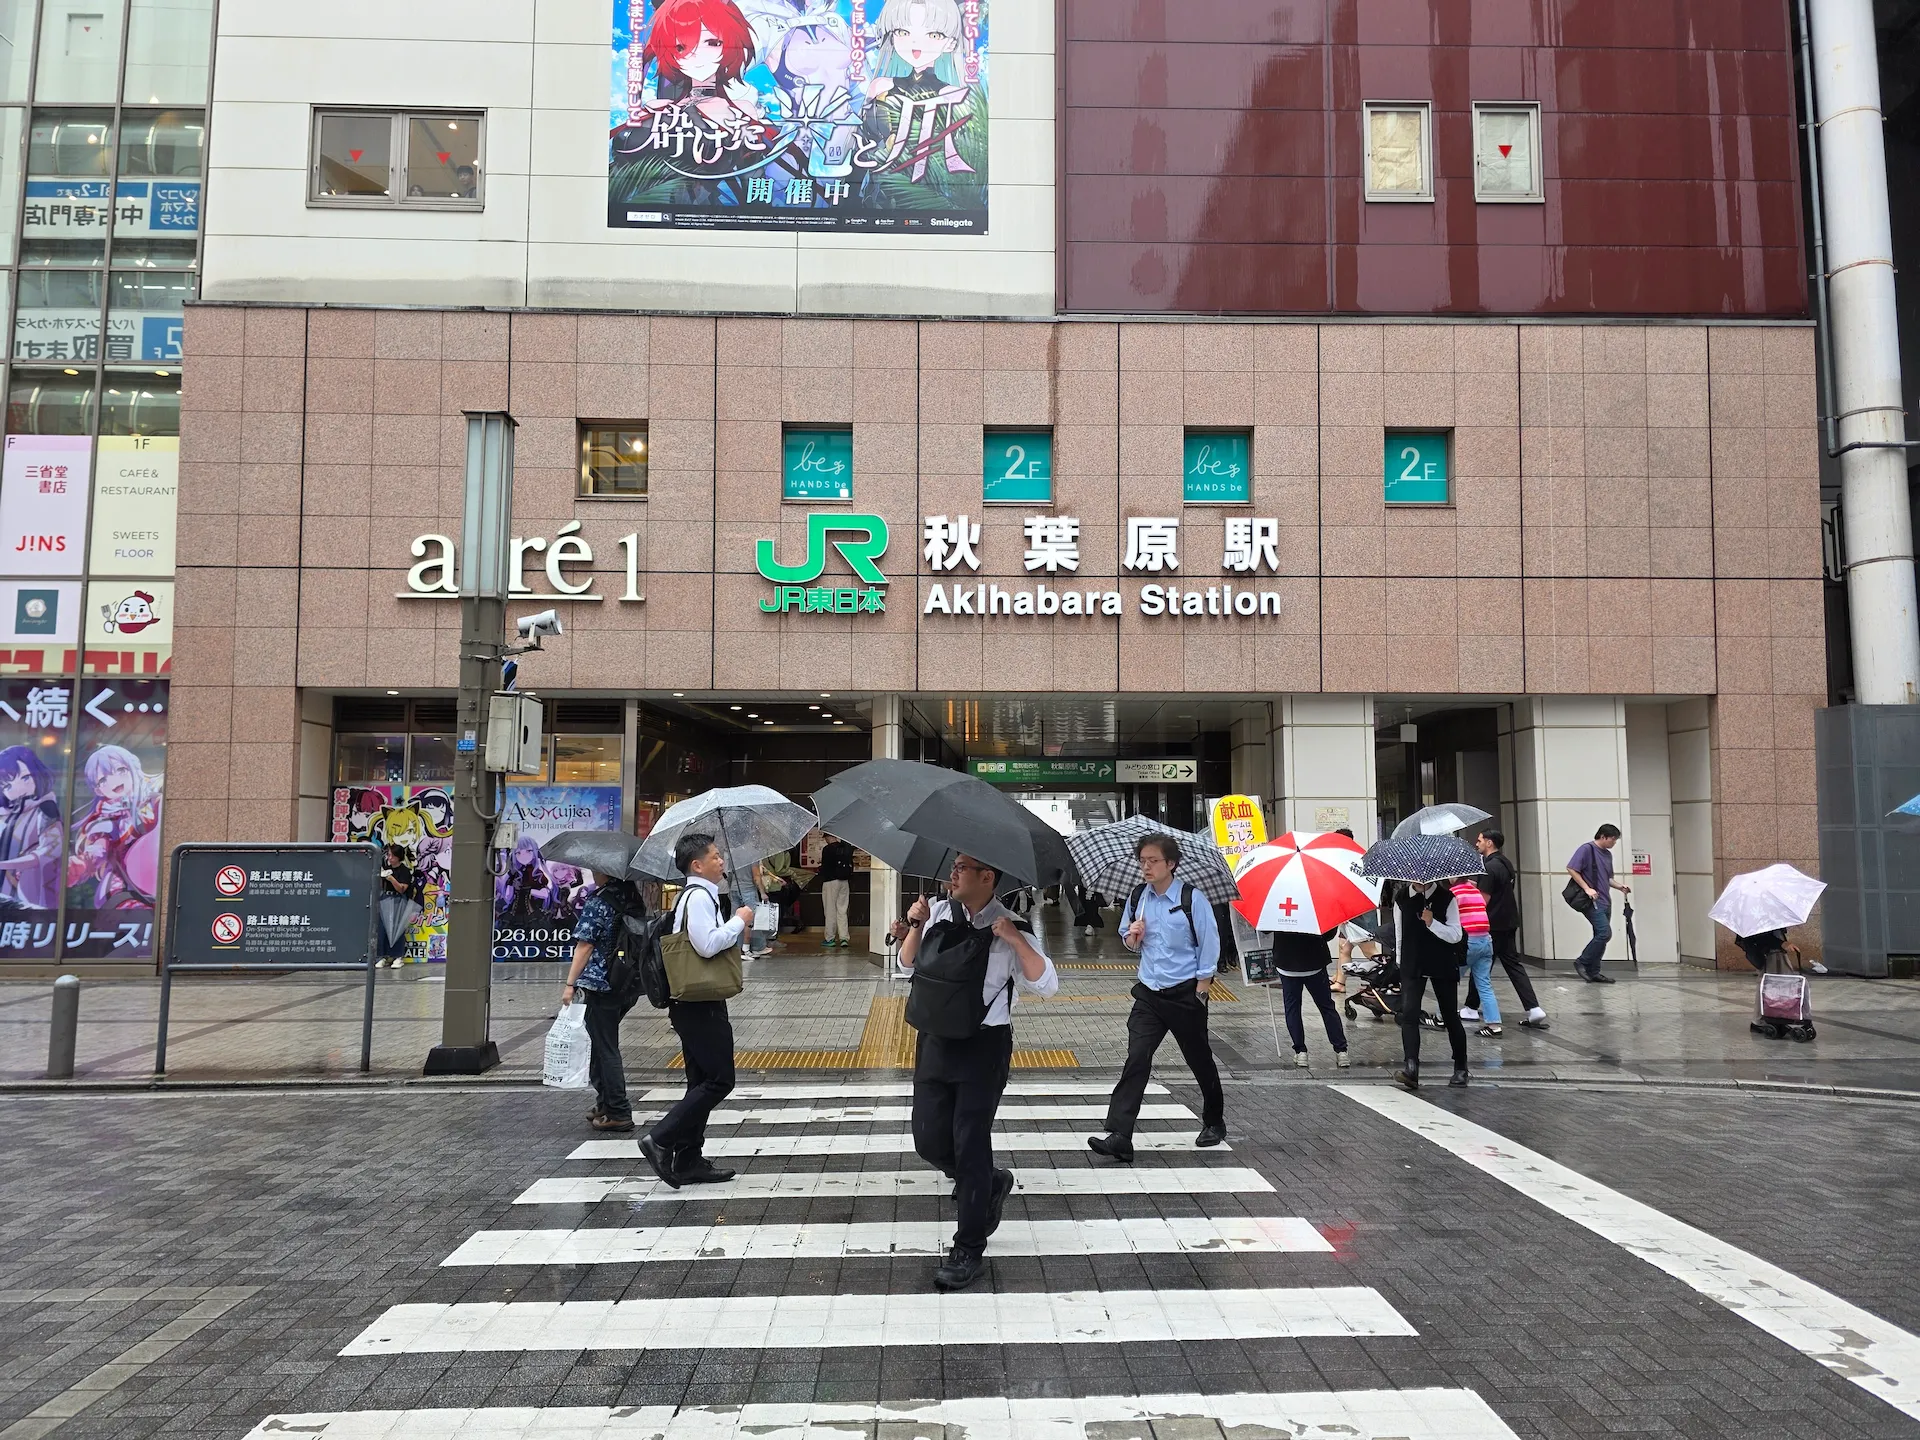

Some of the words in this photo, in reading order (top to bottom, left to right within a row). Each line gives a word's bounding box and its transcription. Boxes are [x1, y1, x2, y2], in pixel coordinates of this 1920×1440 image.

[626, 0, 644, 127] まに…手を動かして」
[746, 177, 851, 206] 開催中
[930, 217, 974, 229] Smilegate
[133, 438, 151, 450] 1F
[1004, 444, 1042, 479] 2F
[1400, 446, 1437, 481] 2F
[25, 465, 69, 479] 三省堂
[38, 480, 68, 495] 書店
[790, 480, 831, 489] HANDS
[834, 479, 847, 489] be
[1187, 483, 1226, 492] HANDS
[1230, 483, 1243, 492] be
[101, 486, 177, 496] RESTAURANT
[112, 531, 160, 541] SWEETS
[755, 512, 890, 585] JR
[923, 514, 1281, 573] 秋葉原駅
[114, 549, 154, 559] FLOOR
[407, 520, 595, 595] aré
[759, 585, 887, 614] JR東日本
[923, 583, 1121, 617] Akihabara
[1140, 583, 1282, 617] Station
[1080, 762, 1096, 772] JR
[1219, 800, 1255, 821] 献血
[1227, 821, 1252, 829] ルームは
[1228, 830, 1256, 843] うしろ
[249, 870, 314, 882] 路上喫煙禁止
[246, 914, 311, 926] 路上駐輪禁止
[0, 922, 153, 950] 時リリース!
[404, 948, 427, 958] ALE!
[492, 945, 541, 958] OAD
[545, 945, 575, 958] SH
